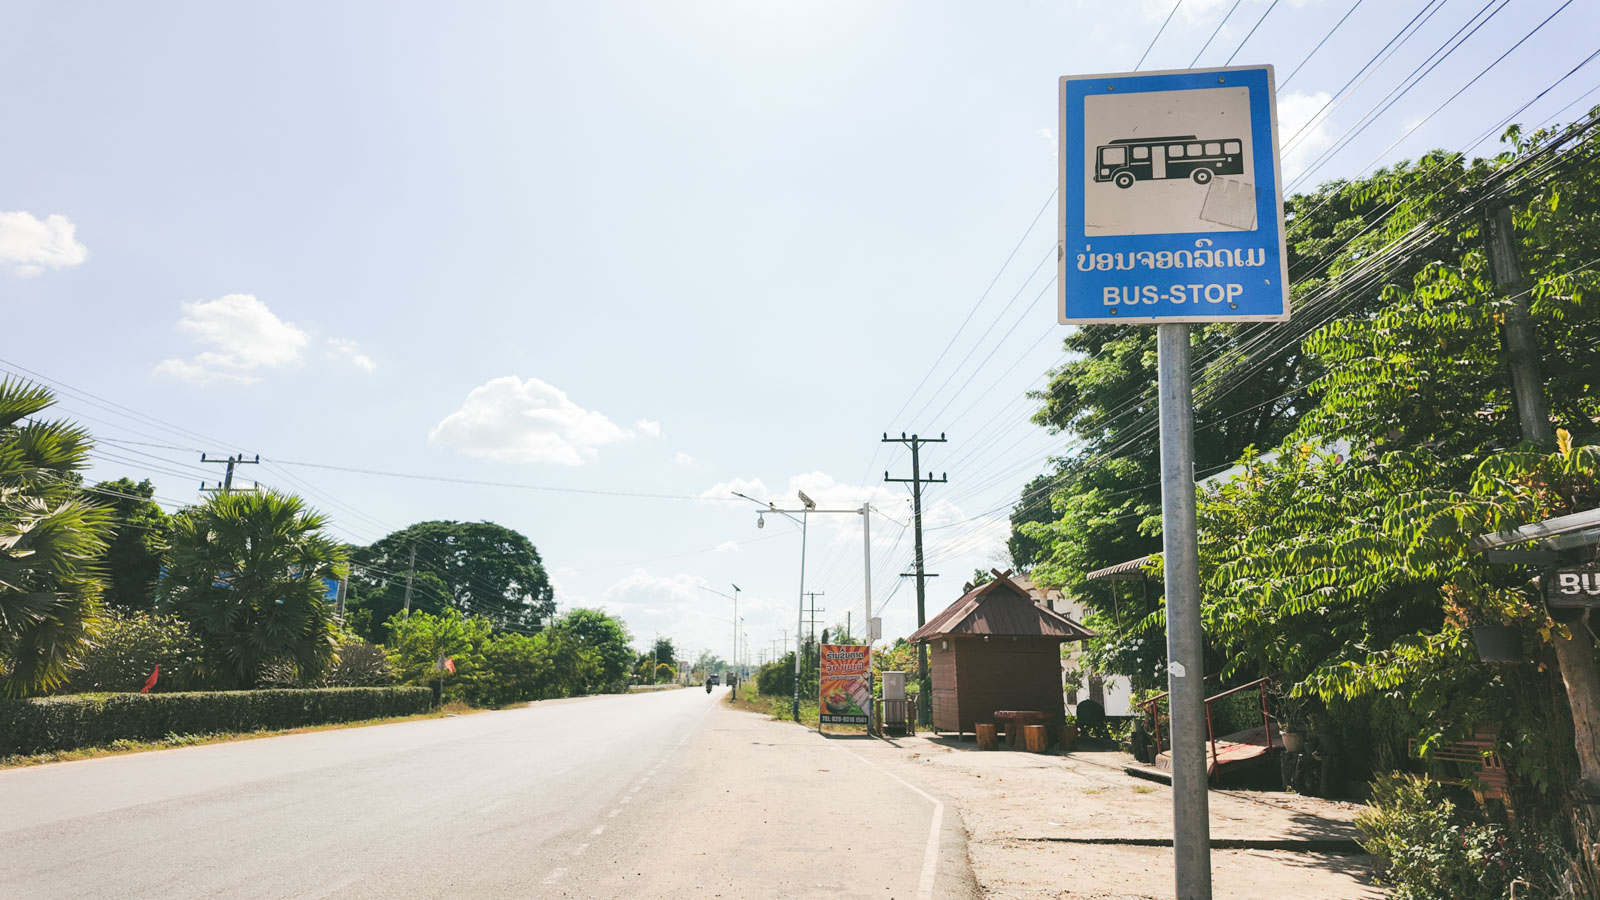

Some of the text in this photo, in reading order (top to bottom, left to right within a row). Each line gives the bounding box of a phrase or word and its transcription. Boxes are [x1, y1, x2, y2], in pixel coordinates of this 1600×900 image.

[1076, 238, 1266, 272] ບ່ອນຈອດລົດເມ
[1102, 283, 1244, 306] BUS-STOP
